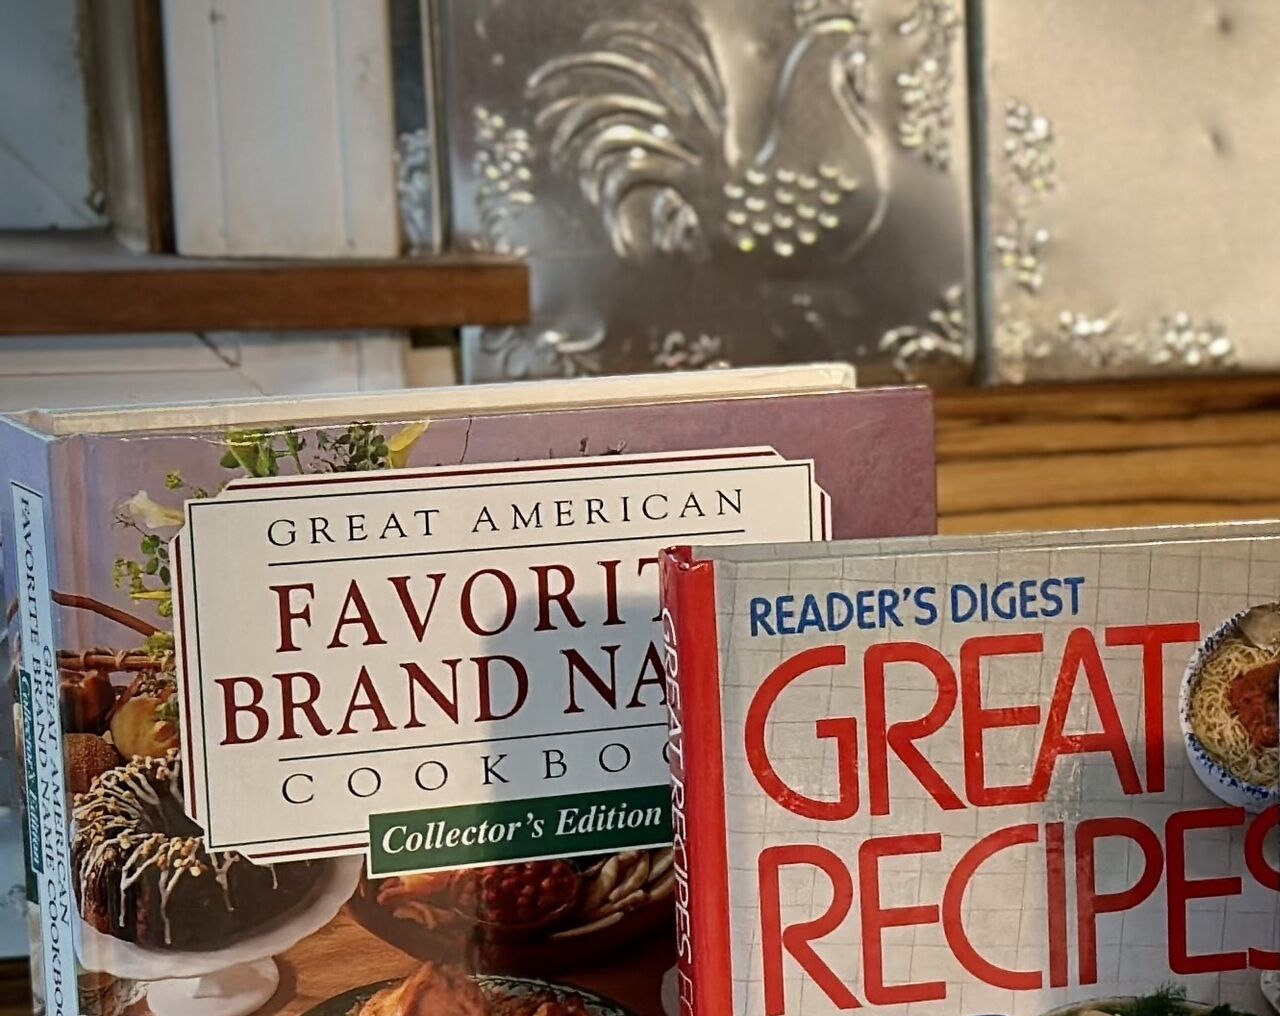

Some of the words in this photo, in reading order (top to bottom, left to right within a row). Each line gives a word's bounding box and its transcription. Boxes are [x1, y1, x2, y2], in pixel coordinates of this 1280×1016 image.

[267, 509, 440, 547] GREAT
[471, 488, 745, 533] AMERICAN
[750, 586, 937, 637] READER'S
[951, 577, 1085, 623] DIGEST
[21, 497, 40, 645] FAVORITE
[32, 657, 48, 768] BRAND
[41, 780, 55, 871] NAME
[43, 645, 59, 750] GREAT
[214, 655, 529, 746] BRAND
[559, 640, 667, 714] NA
[662, 608, 684, 770] GREAT
[744, 621, 1200, 821] GREAT
[281, 741, 669, 804] COOKBO
[50, 757, 69, 926] AMERICAN
[382, 813, 544, 855] Collector's
[555, 802, 662, 836] Edition
[670, 774, 693, 965] RECIPES
